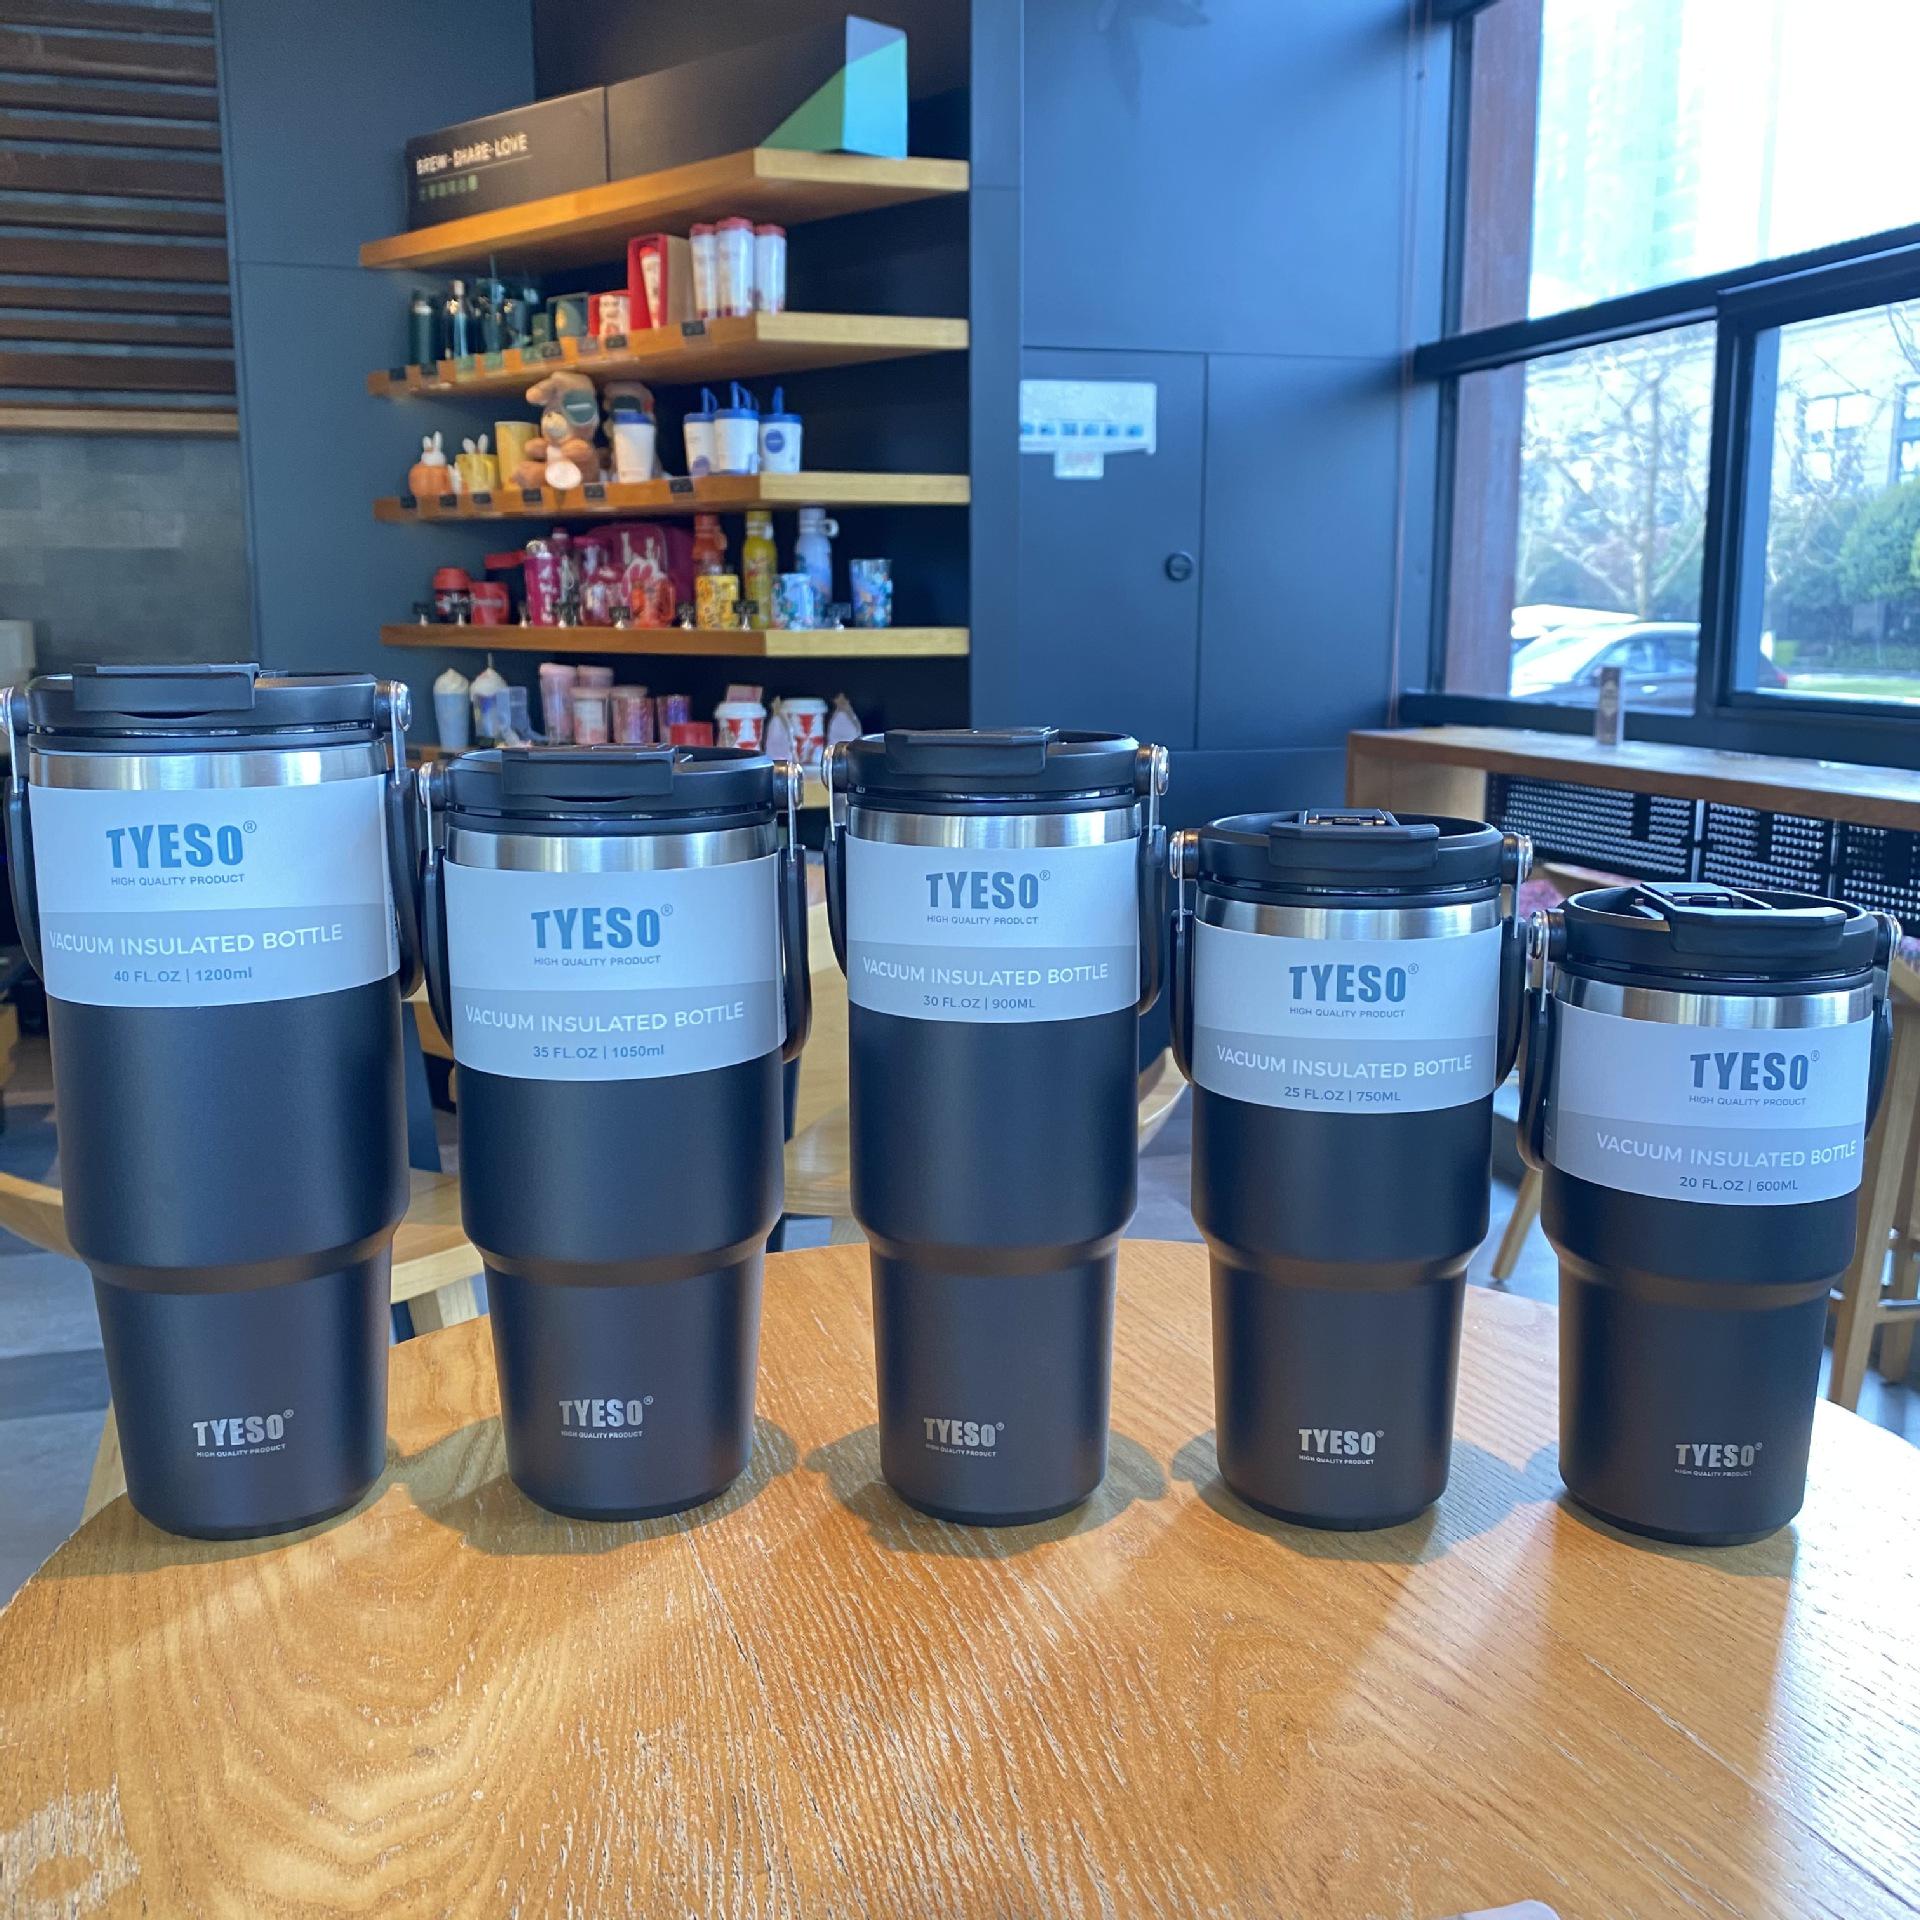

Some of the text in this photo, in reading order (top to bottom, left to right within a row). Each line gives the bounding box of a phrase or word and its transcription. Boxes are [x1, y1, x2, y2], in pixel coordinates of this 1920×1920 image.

[111, 874, 245, 886] HIGH QUALITY PRODUCT
[927, 915, 1039, 925] HIGH QUALITY PRODUCT
[50, 924, 343, 955] VACUUM INSULATED BOTTLE
[534, 955, 661, 967] HIGH QUALITY PRODUCT
[114, 970, 129, 982] 40
[195, 967, 252, 981] 1200ml
[863, 957, 1108, 986] VACUUM INSULATED BOTTLE
[923, 995, 938, 1006] 30
[993, 997, 1035, 1008] 900ML
[465, 1002, 744, 1032] VACUUM INSULATED BOTTLE
[1289, 1007, 1405, 1018] HIGH QUALITY PRODUCT
[533, 1046, 549, 1058] 35
[612, 1044, 664, 1058] 1050ml
[1217, 1045, 1472, 1079] VACUUM INSULATED BOTTLE
[1284, 1086, 1299, 1097] 25
[1357, 1091, 1400, 1101] 750ML
[1689, 1095, 1807, 1106] HIGH QUALITY PRODUCT
[1597, 1132, 1856, 1168] VACUUM INSULATED BOTTLE
[1680, 1177, 1697, 1188] 20
[1757, 1180, 1798, 1191] 600ML
